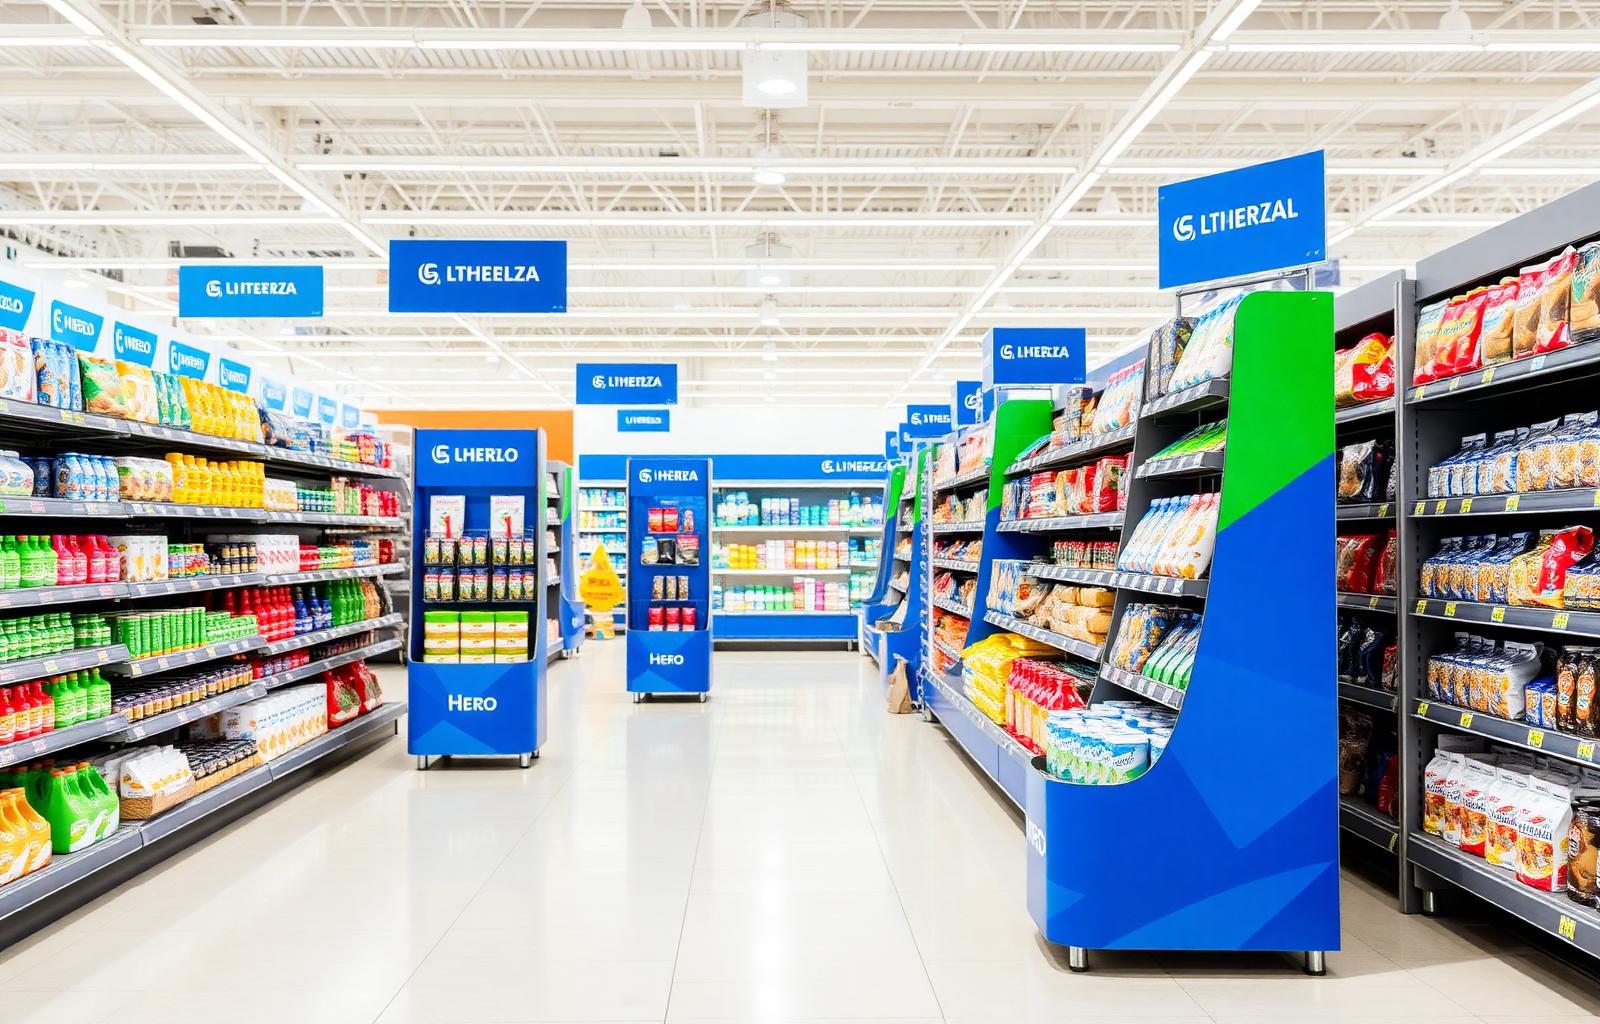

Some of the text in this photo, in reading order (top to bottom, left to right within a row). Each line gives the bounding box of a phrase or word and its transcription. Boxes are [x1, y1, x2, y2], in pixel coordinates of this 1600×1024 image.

[446, 265, 540, 282] LTHEELZA
[650, 652, 684, 665] HERO
[448, 694, 497, 711] HERO
